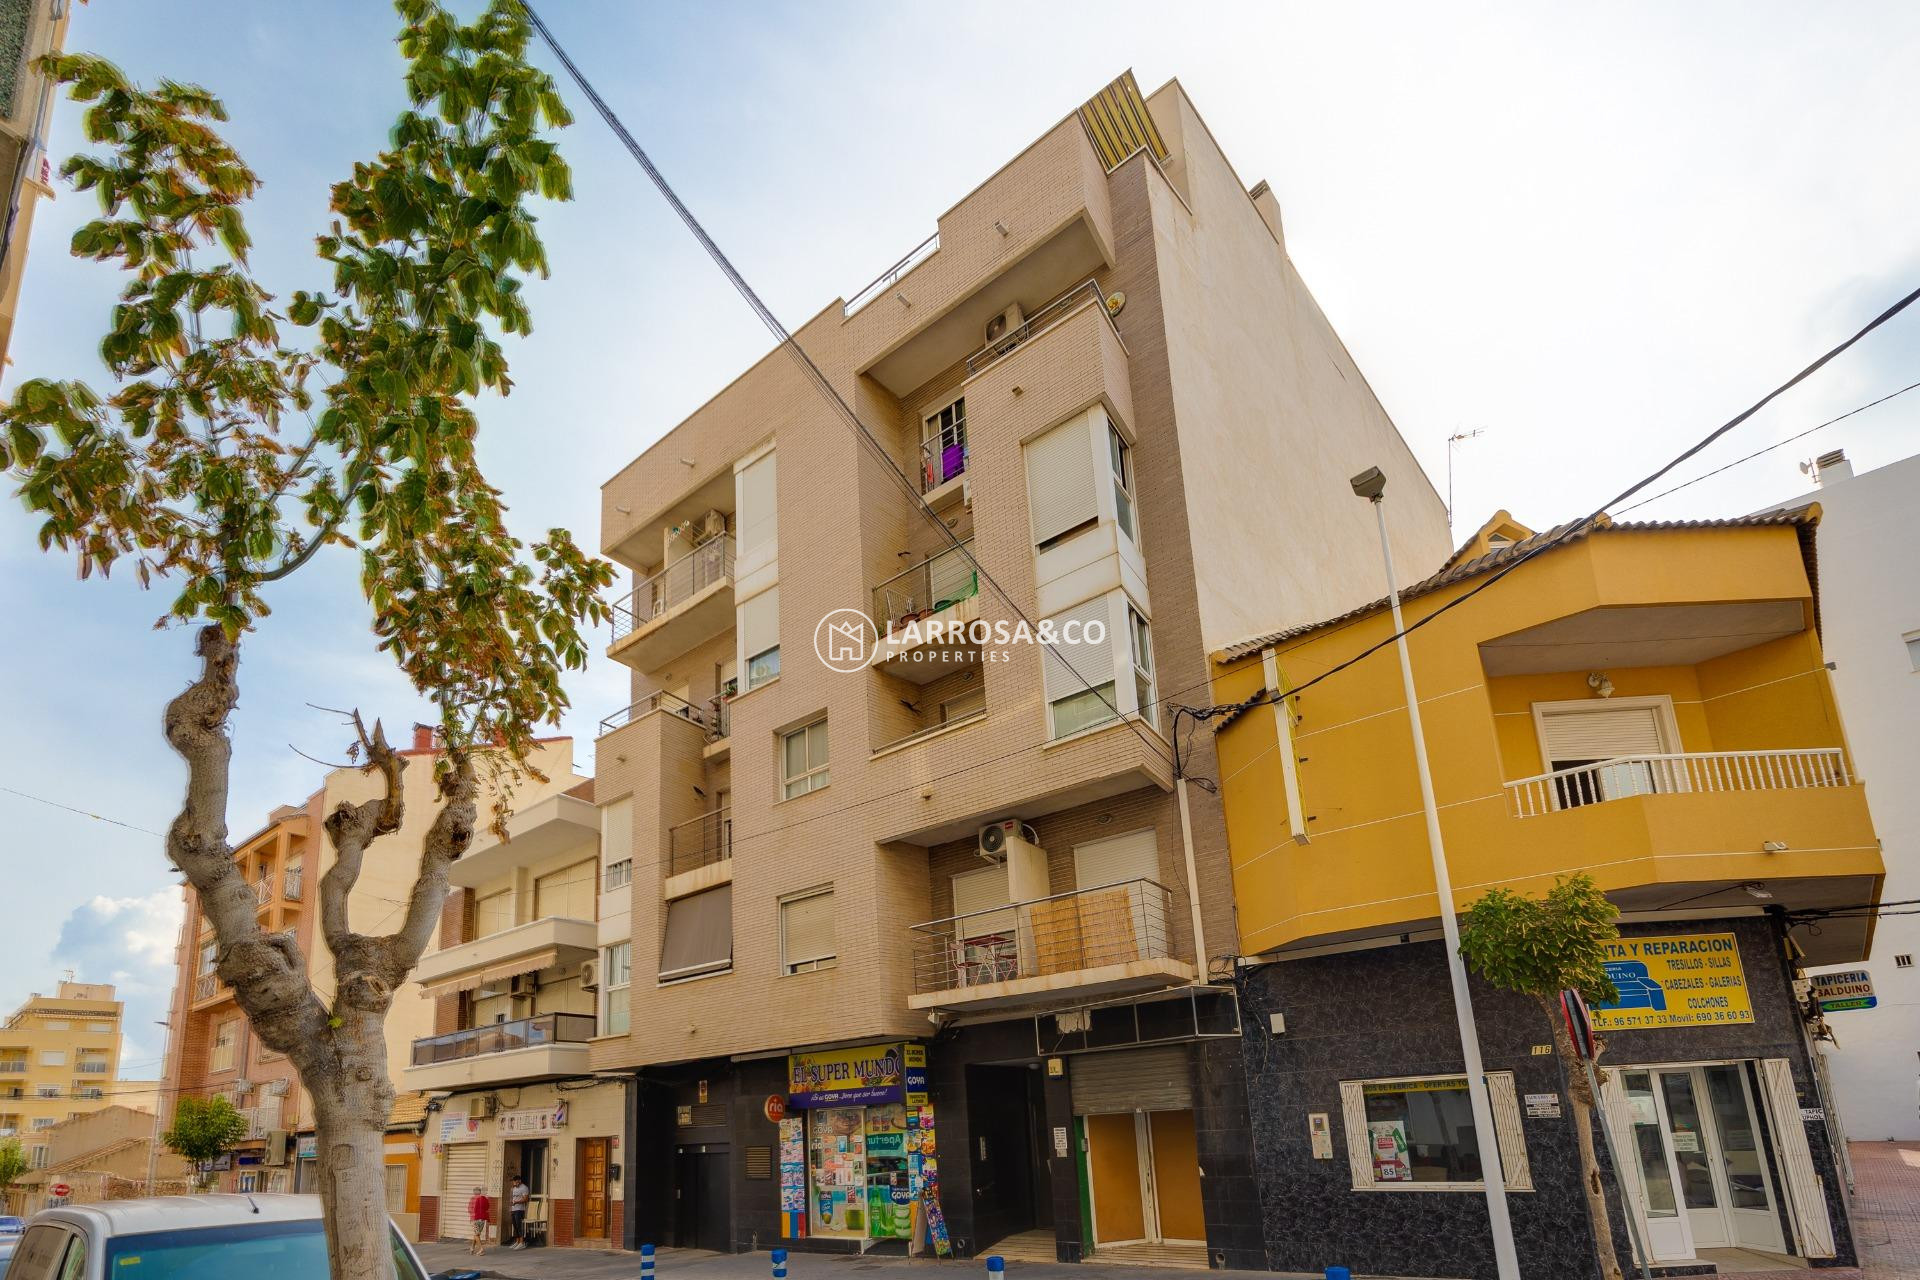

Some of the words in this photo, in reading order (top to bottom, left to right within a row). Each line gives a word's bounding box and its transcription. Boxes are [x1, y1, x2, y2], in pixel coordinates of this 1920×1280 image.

[1629, 943, 1639, 956] Y
[1643, 939, 1733, 955] REPARACION
[1666, 959, 1704, 970] TRESILLOS
[1709, 957, 1731, 968] SILLAS
[1664, 978, 1704, 990] CABEZALES
[1709, 976, 1742, 988] GALERIAS
[1815, 972, 1868, 986] TAPICERIA
[1687, 997, 1729, 1009] COLCHONES
[1614, 1017, 1625, 1026] 96
[1627, 1016, 1641, 1025] 571
[1645, 1015, 1654, 1024] 37
[1657, 1015, 1667, 1024] 33
[1696, 1013, 1711, 1021] 690
[1715, 1012, 1724, 1020] 36
[1727, 1011, 1737, 1019] 60
[1740, 1010, 1749, 1019] 93
[1534, 1046, 1551, 1055] 116
[793, 1066, 807, 1084] EL
[811, 1061, 850, 1083] SUPER
[907, 1076, 925, 1085] GOYA
[824, 1093, 839, 1101] GOYA
[769, 1098, 783, 1112] ria
[1383, 1168, 1394, 1176] 85
